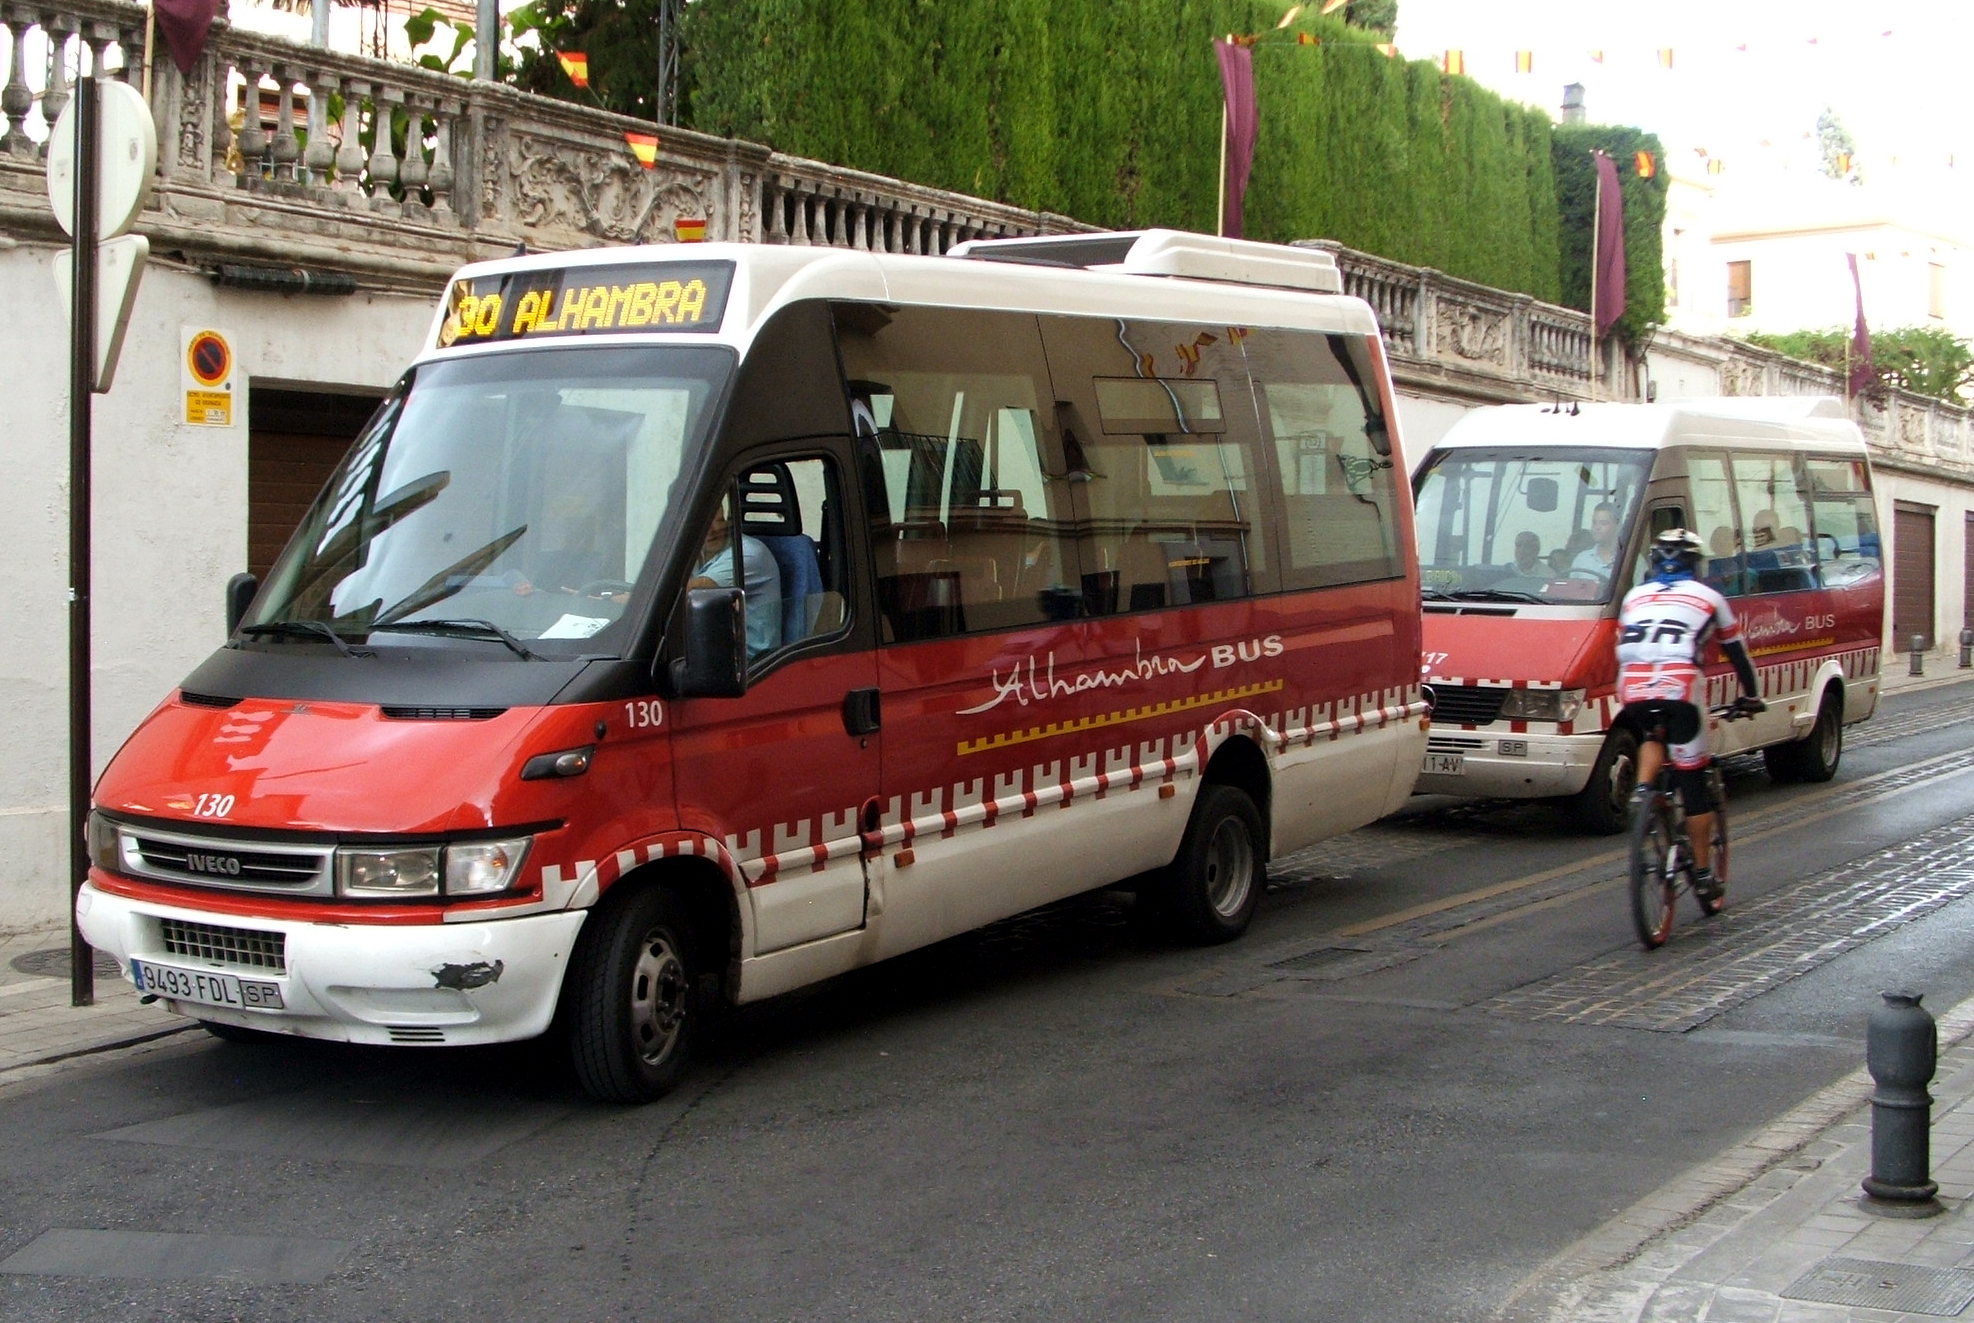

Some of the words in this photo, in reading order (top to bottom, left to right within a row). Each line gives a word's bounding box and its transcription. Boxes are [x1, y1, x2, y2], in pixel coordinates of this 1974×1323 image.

[455, 294, 502, 337] 30
[512, 279, 707, 334] ALHAMBRA
[1738, 606, 1801, 640] lhambra
[1805, 613, 1836, 630] BUS
[955, 636, 1207, 714] Alhambra
[1211, 634, 1284, 669] BUS
[624, 700, 663, 728] 130
[1502, 742, 1524, 753] SP
[193, 793, 236, 818] 130
[187, 853, 241, 876] IVECO
[143, 966, 192, 998] 9493
[195, 975, 238, 1004] FDL
[246, 985, 276, 1004] SP
